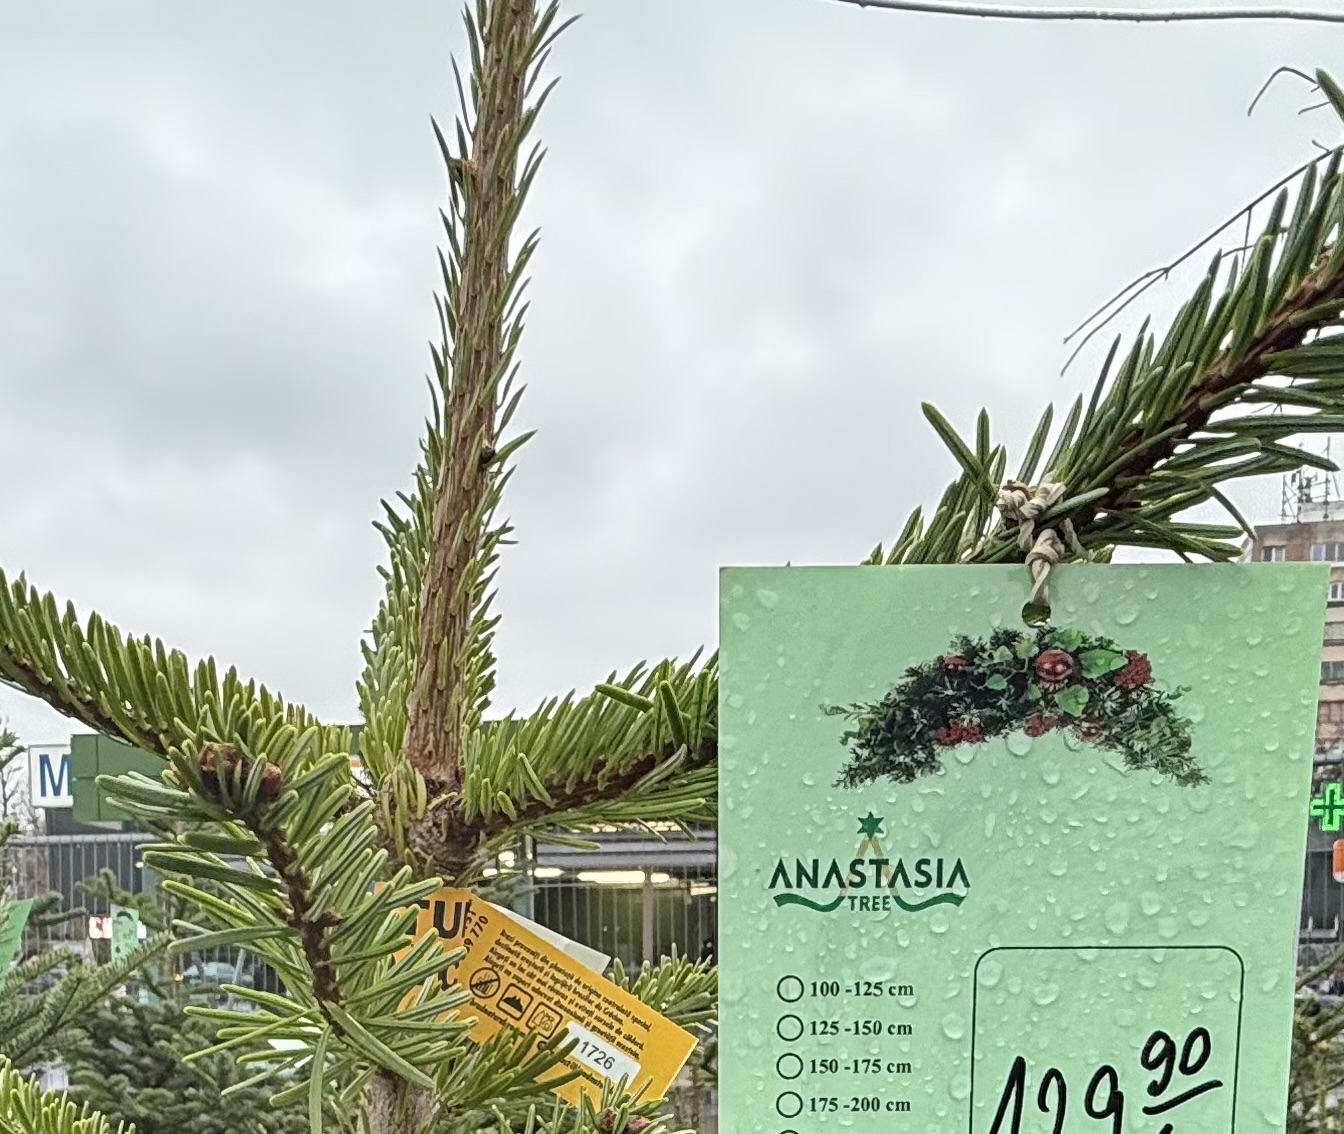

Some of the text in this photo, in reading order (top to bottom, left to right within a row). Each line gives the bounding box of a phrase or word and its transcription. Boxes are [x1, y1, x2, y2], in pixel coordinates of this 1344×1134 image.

[39, 754, 70, 797] M
[768, 857, 971, 889] ANASTASIA
[847, 895, 892, 912] TREE
[811, 981, 840, 996] 100
[888, 985, 914, 996] cm
[810, 1020, 839, 1035] 125
[888, 1024, 913, 1035] cm
[578, 1040, 615, 1070] 1726
[1141, 1027, 1212, 1097] 90
[810, 1059, 839, 1074] 150
[887, 1063, 912, 1074] cm
[810, 1098, 839, 1112] 175
[886, 1102, 912, 1112] cm
